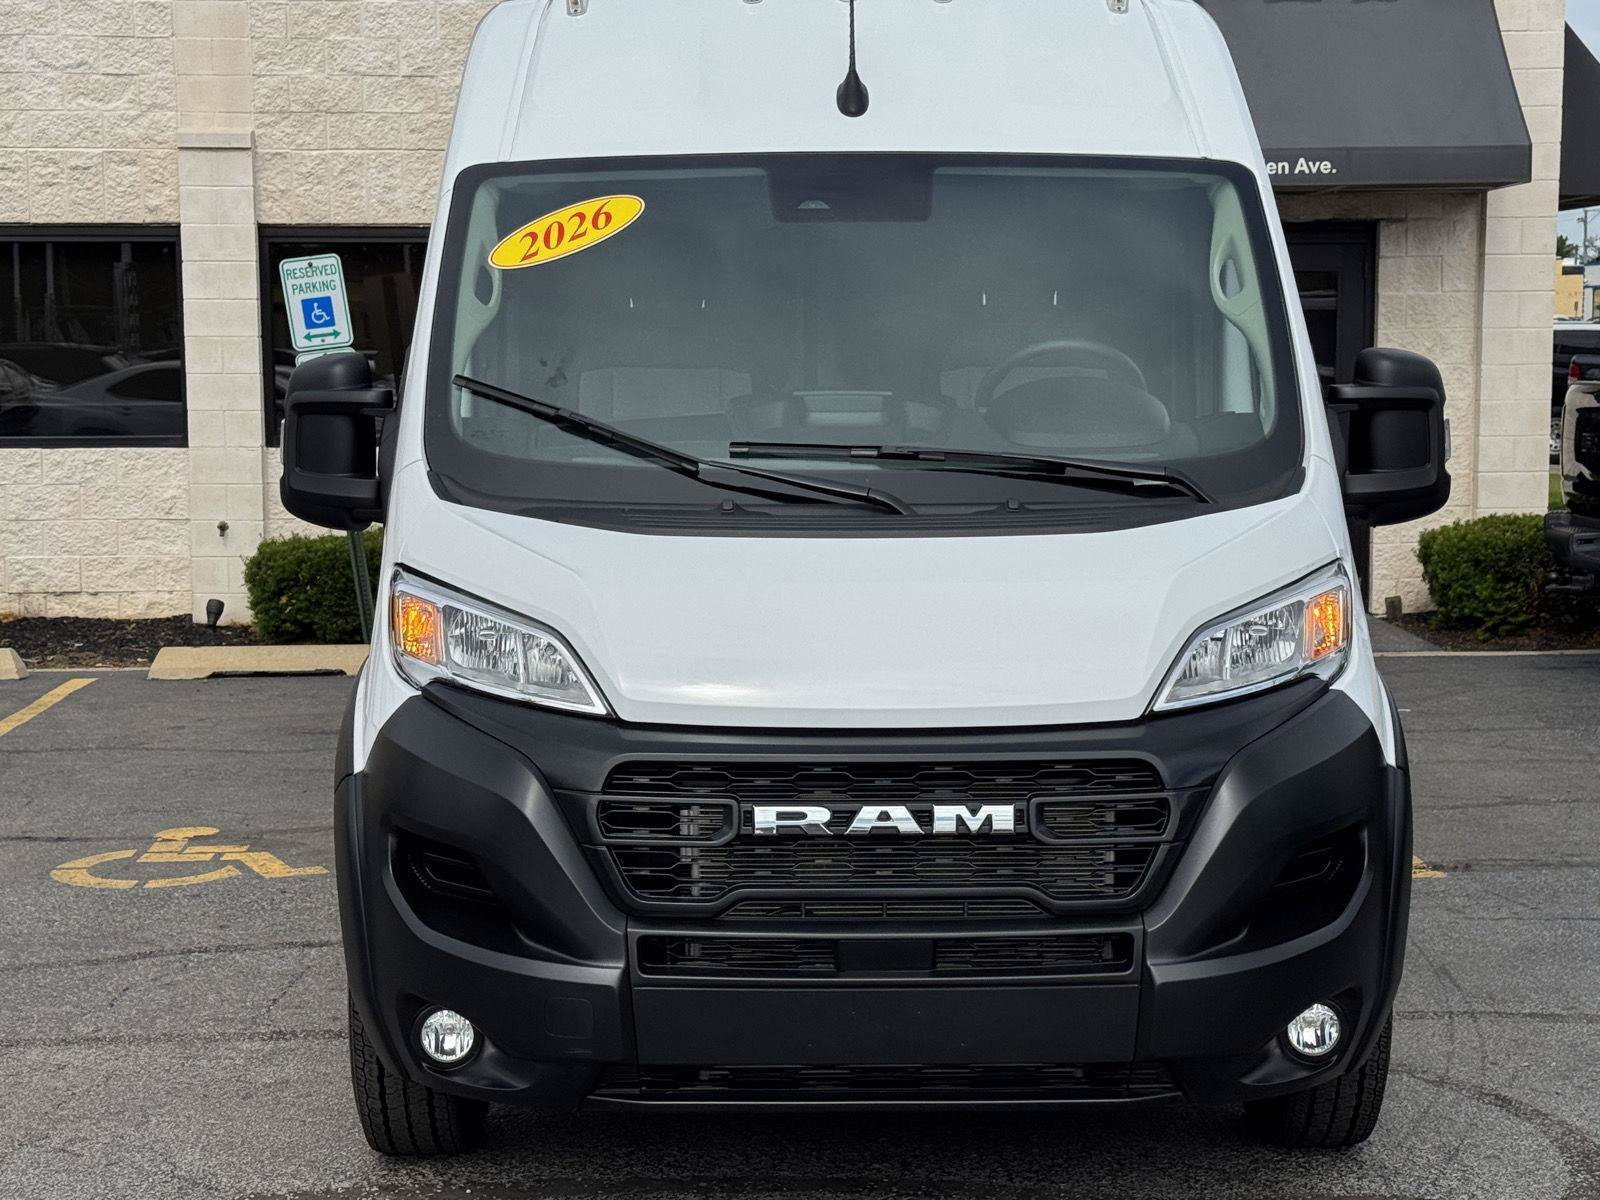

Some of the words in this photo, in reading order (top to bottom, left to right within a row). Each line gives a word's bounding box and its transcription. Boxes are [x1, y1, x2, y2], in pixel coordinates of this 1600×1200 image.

[1294, 157, 1337, 174] Ave.
[519, 200, 613, 263] 2026
[285, 263, 337, 281] RESERVED
[292, 279, 337, 295] PARKING
[753, 804, 1015, 834] RAM
